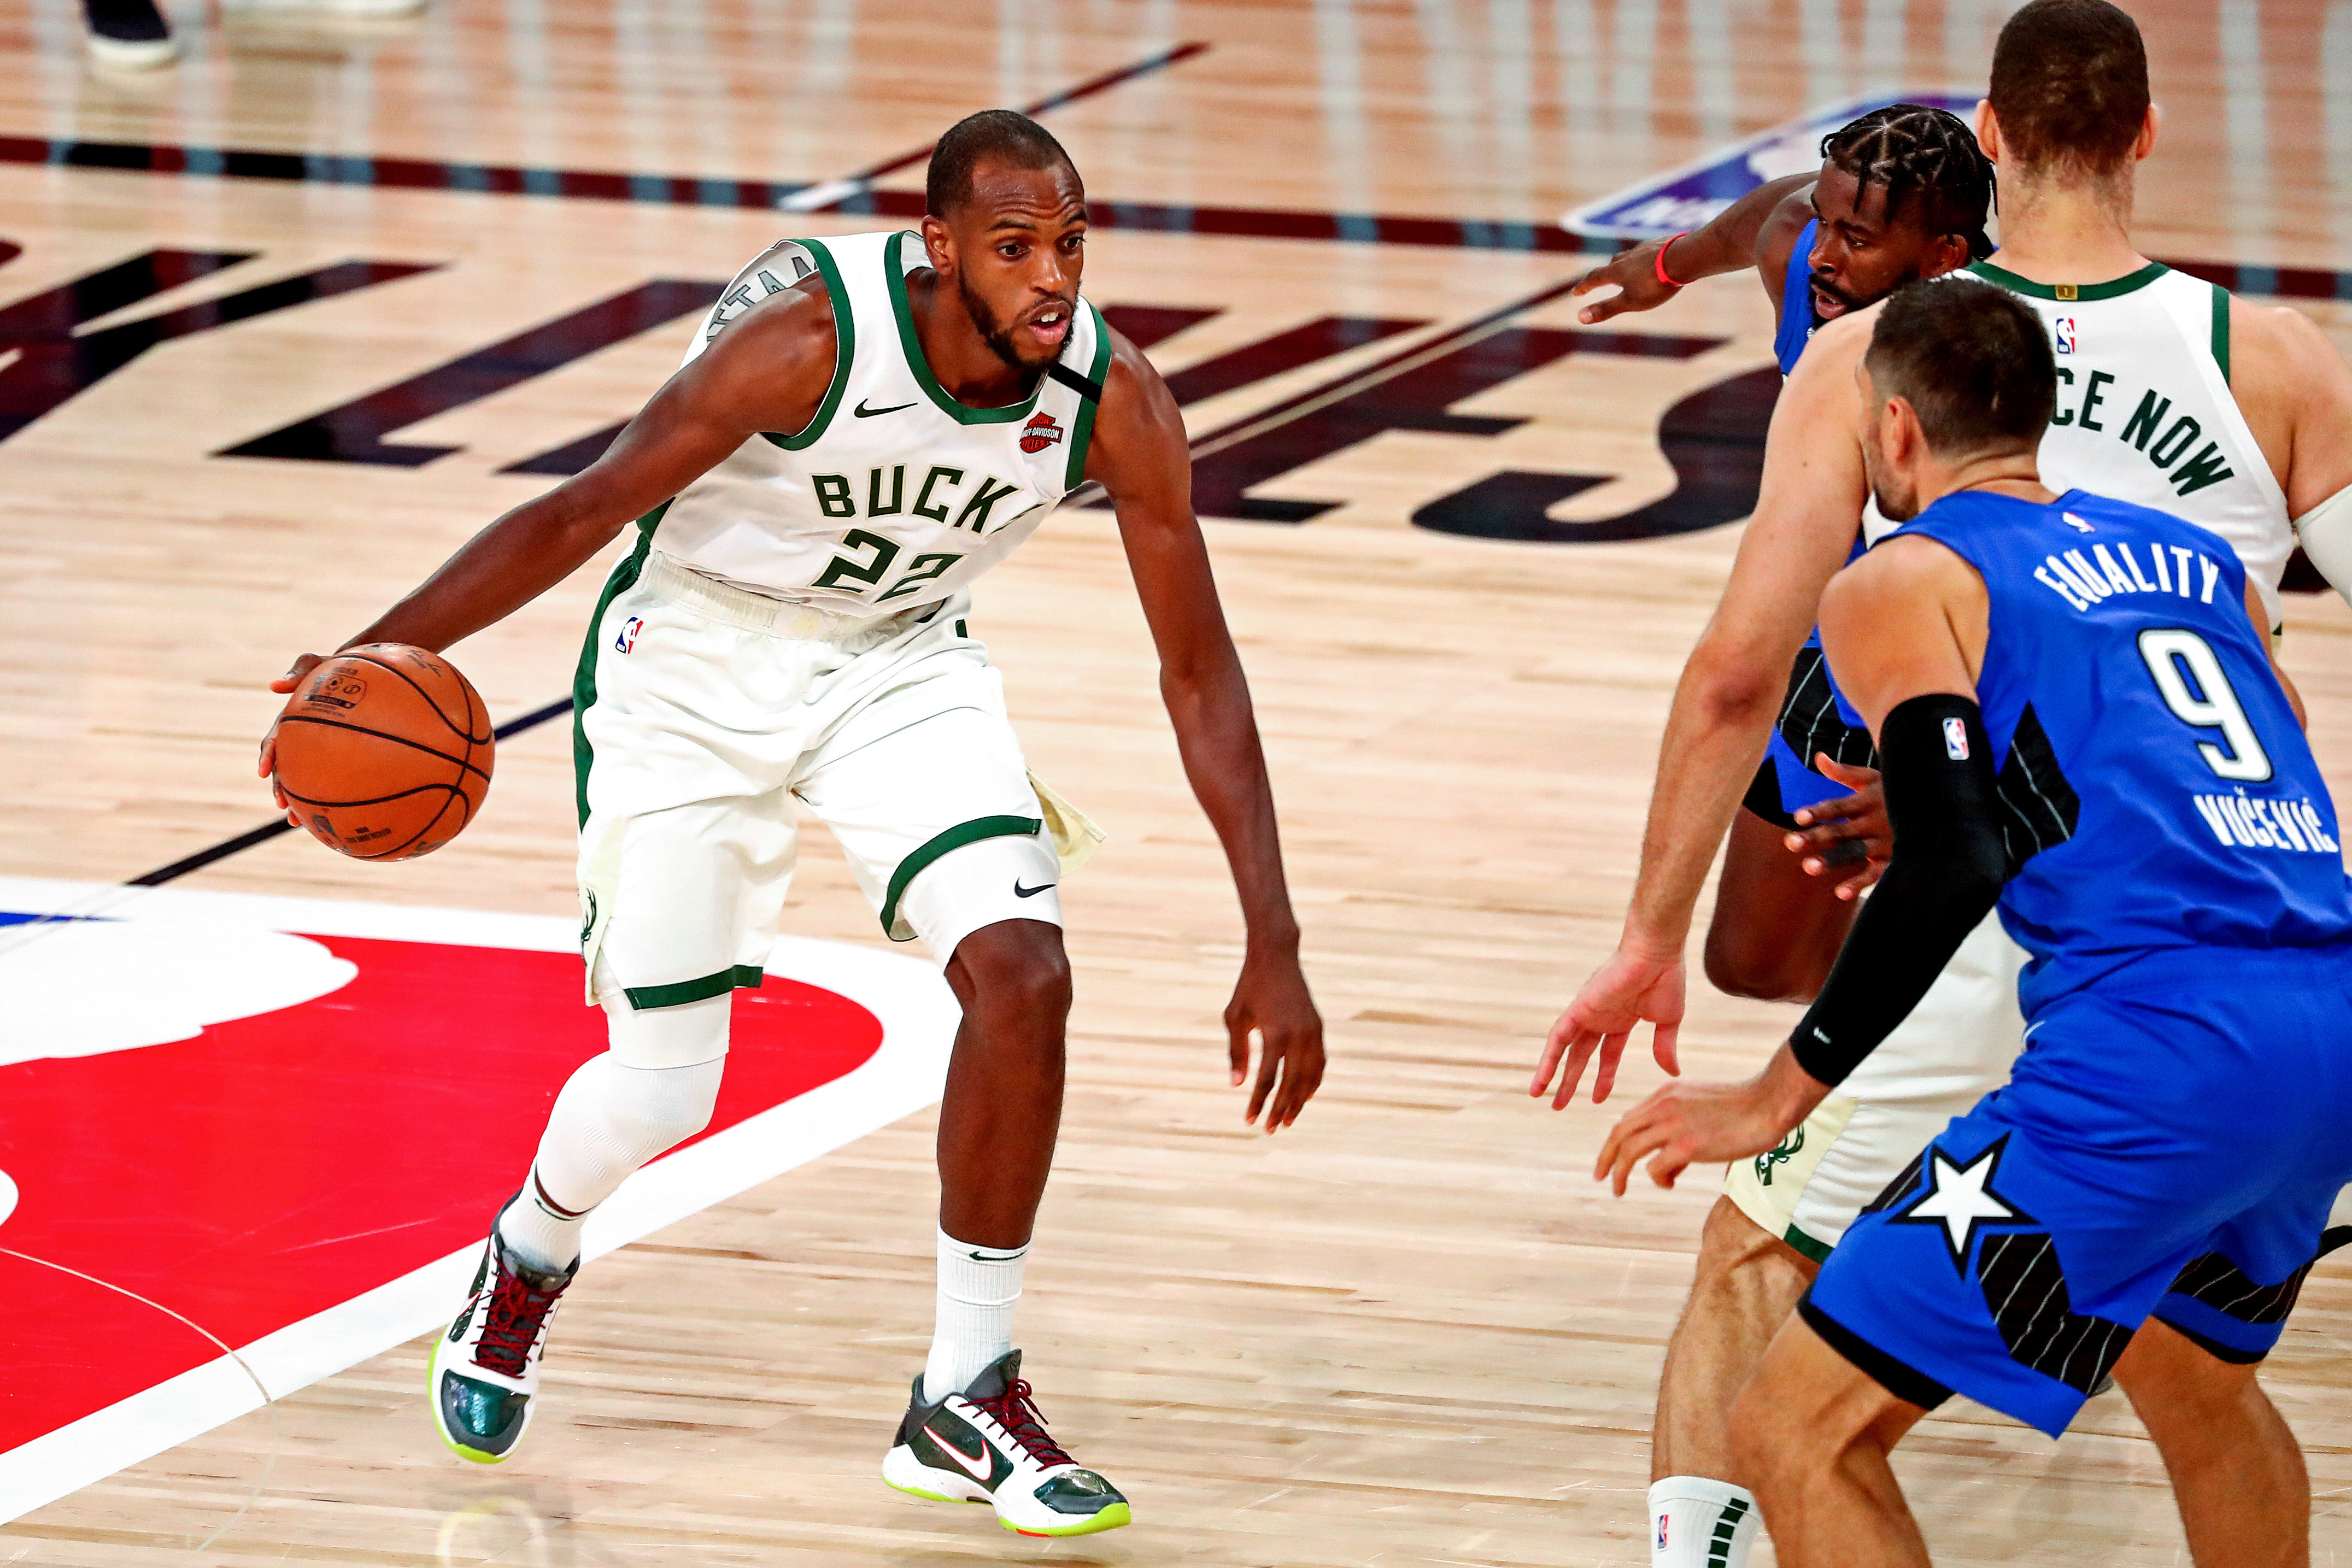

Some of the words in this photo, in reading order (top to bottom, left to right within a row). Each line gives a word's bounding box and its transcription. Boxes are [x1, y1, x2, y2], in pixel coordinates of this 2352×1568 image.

[2120, 389, 2234, 497] NOW
[811, 465, 1039, 536] BUCK
[810, 528, 970, 604] 22
[2033, 543, 2220, 612] EQUALITY
[2138, 627, 2274, 783] 9
